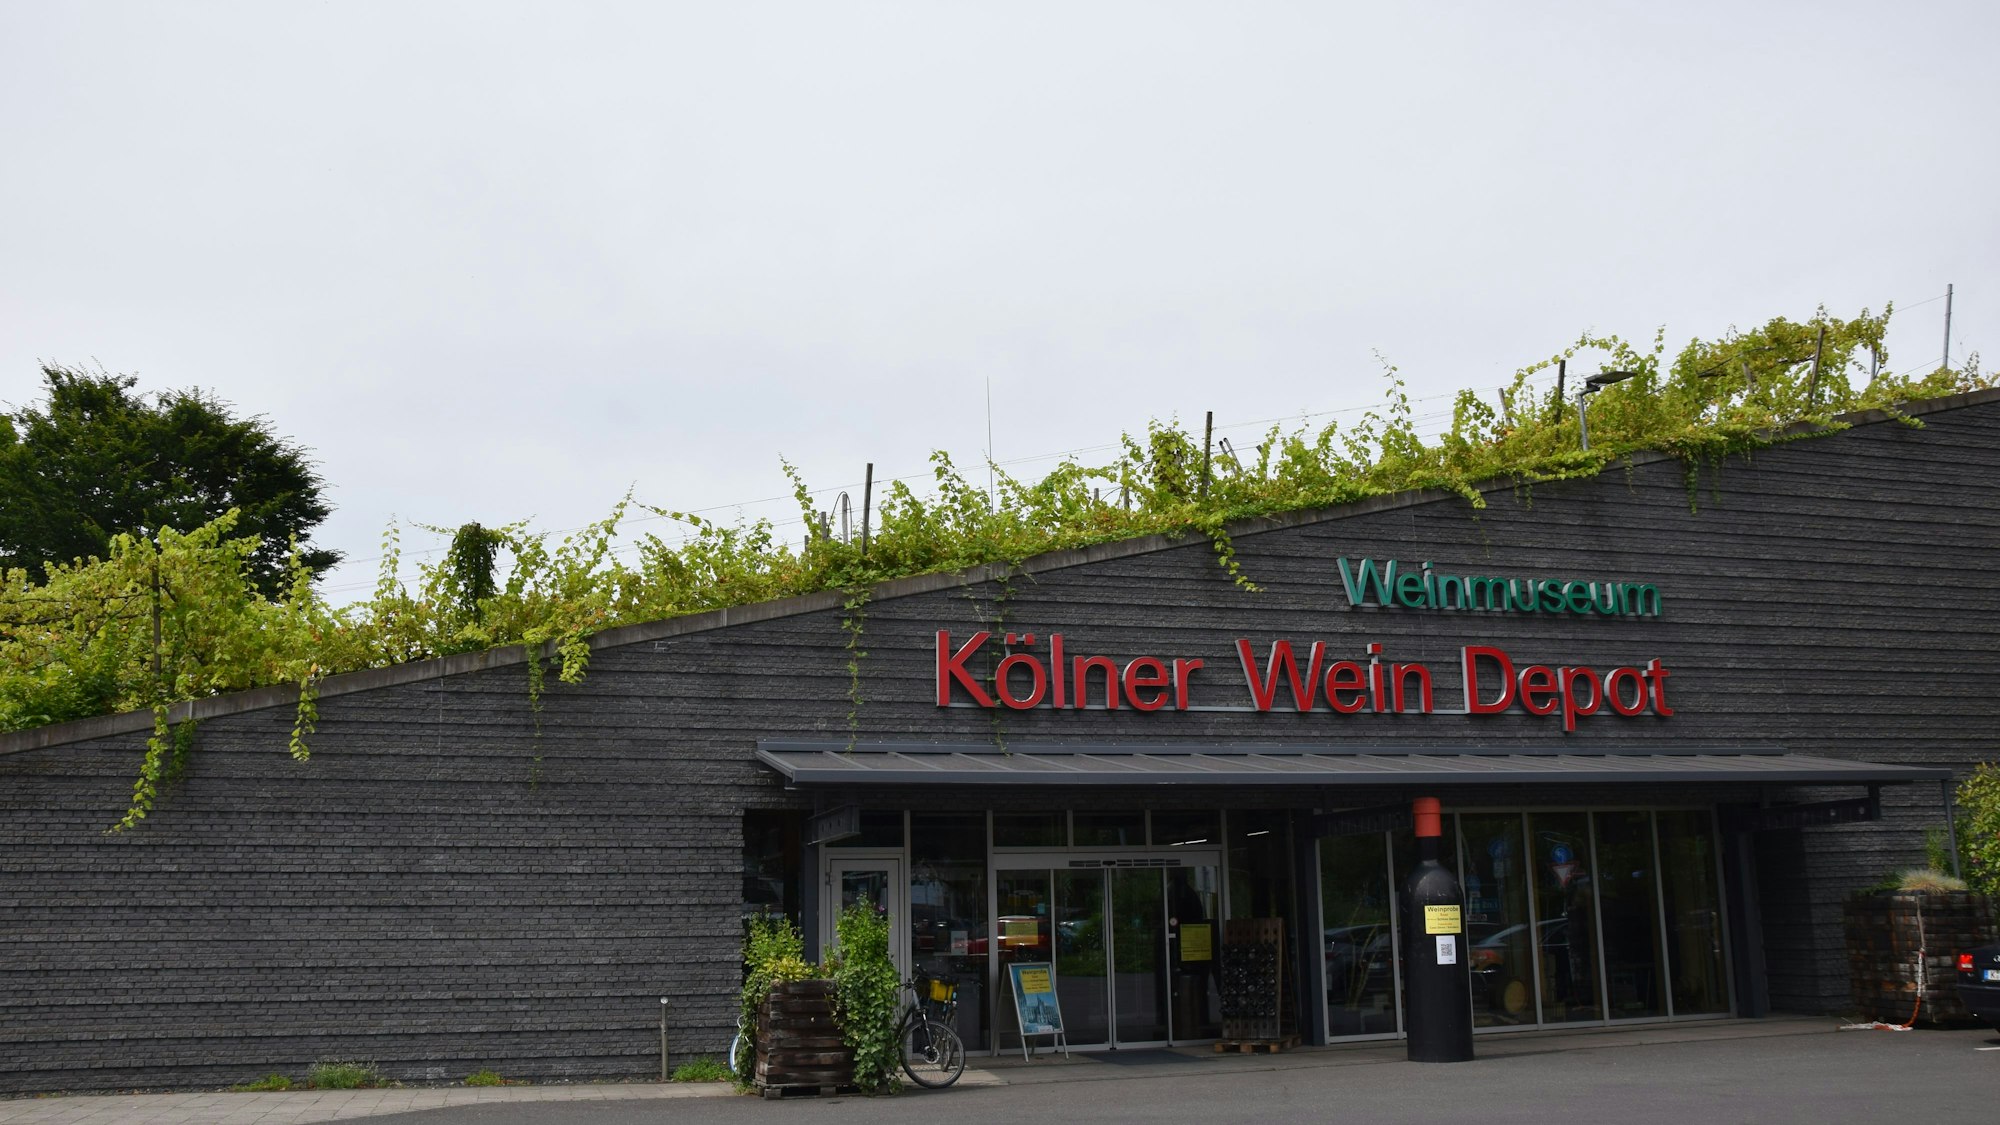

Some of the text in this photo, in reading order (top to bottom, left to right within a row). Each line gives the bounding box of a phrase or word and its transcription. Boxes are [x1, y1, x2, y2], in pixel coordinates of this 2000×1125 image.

[1336, 557, 1663, 617] Weinmuseum
[936, 629, 1674, 732] Kölner Wein Depot
